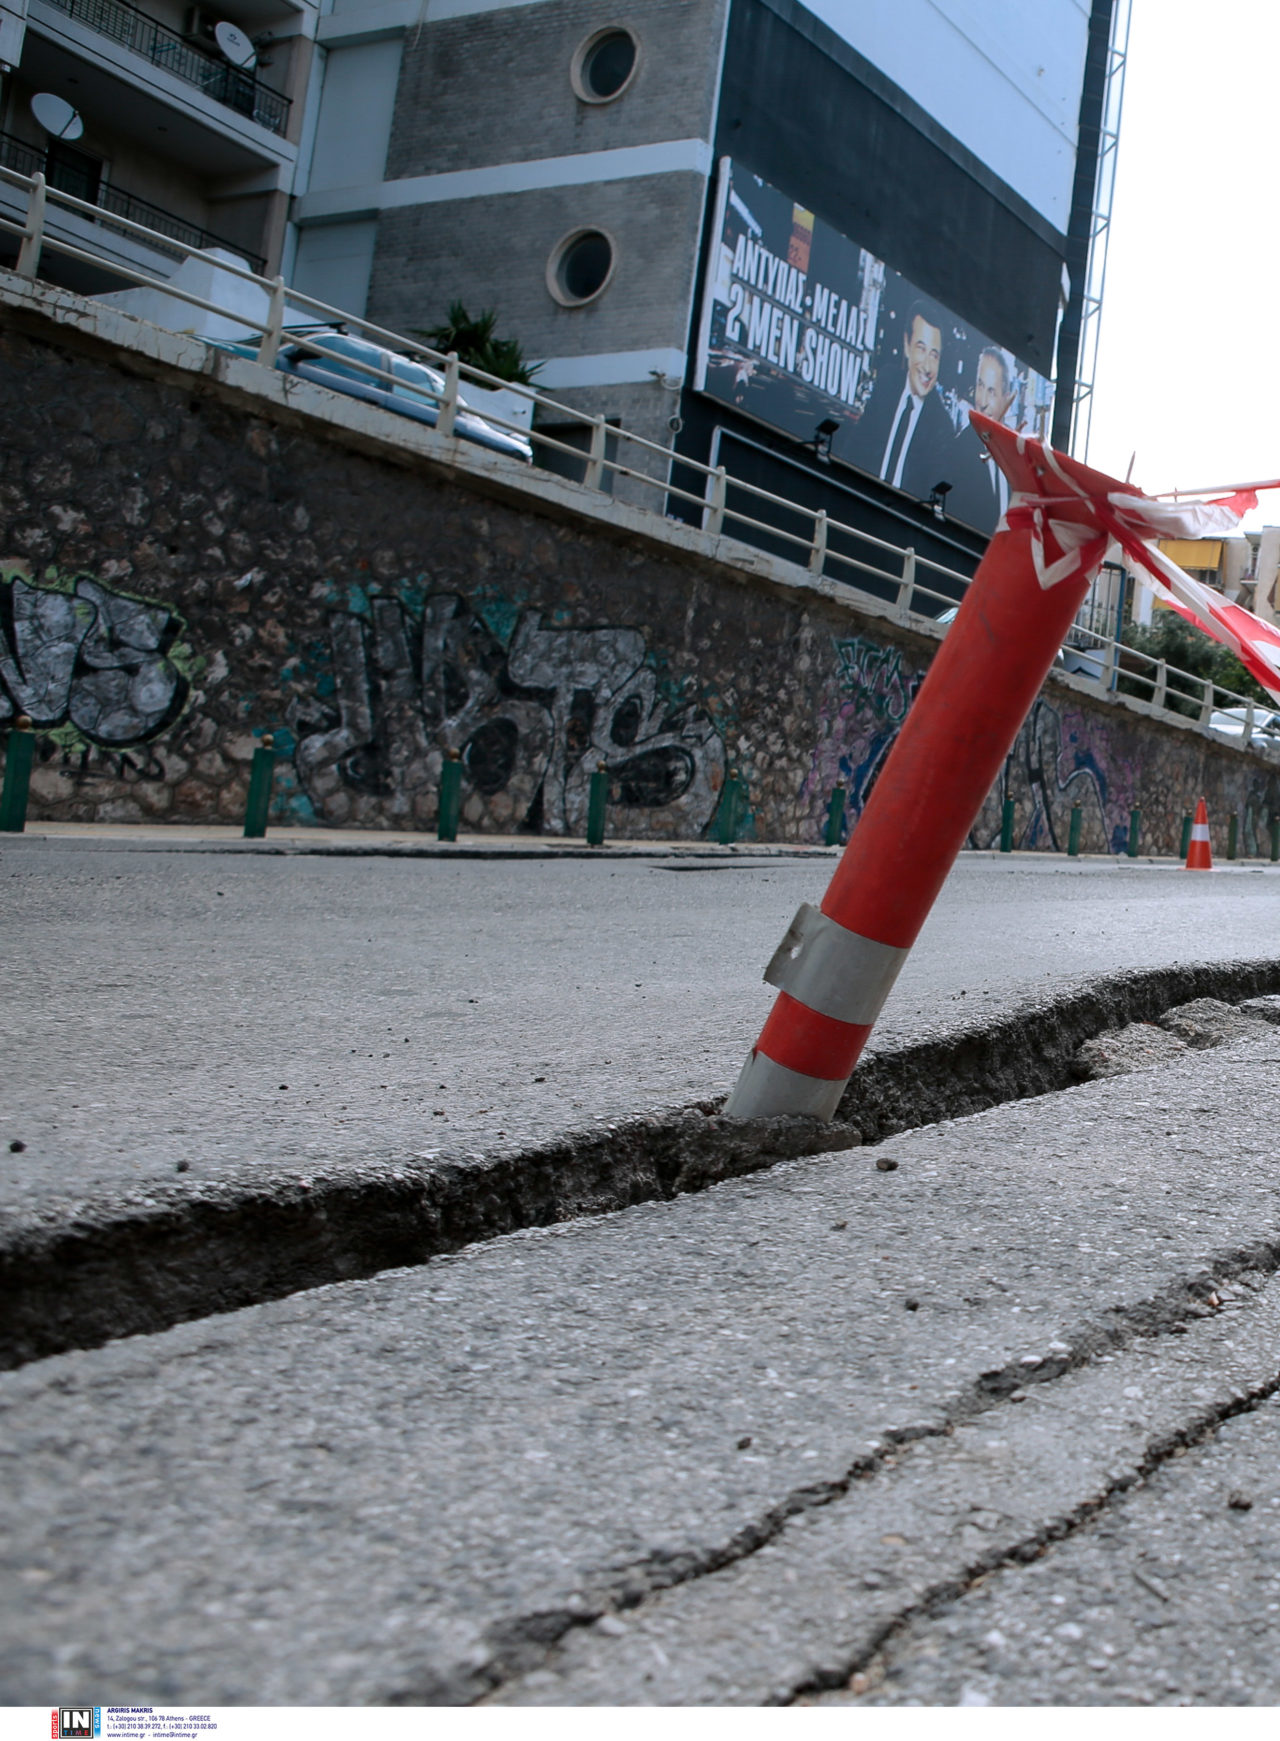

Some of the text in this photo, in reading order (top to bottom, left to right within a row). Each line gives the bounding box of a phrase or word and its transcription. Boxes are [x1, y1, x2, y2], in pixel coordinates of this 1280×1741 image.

[732, 233, 808, 315] ΑΝΤΥΠΑΣ
[725, 283, 862, 405] 2 MEN SHOW
